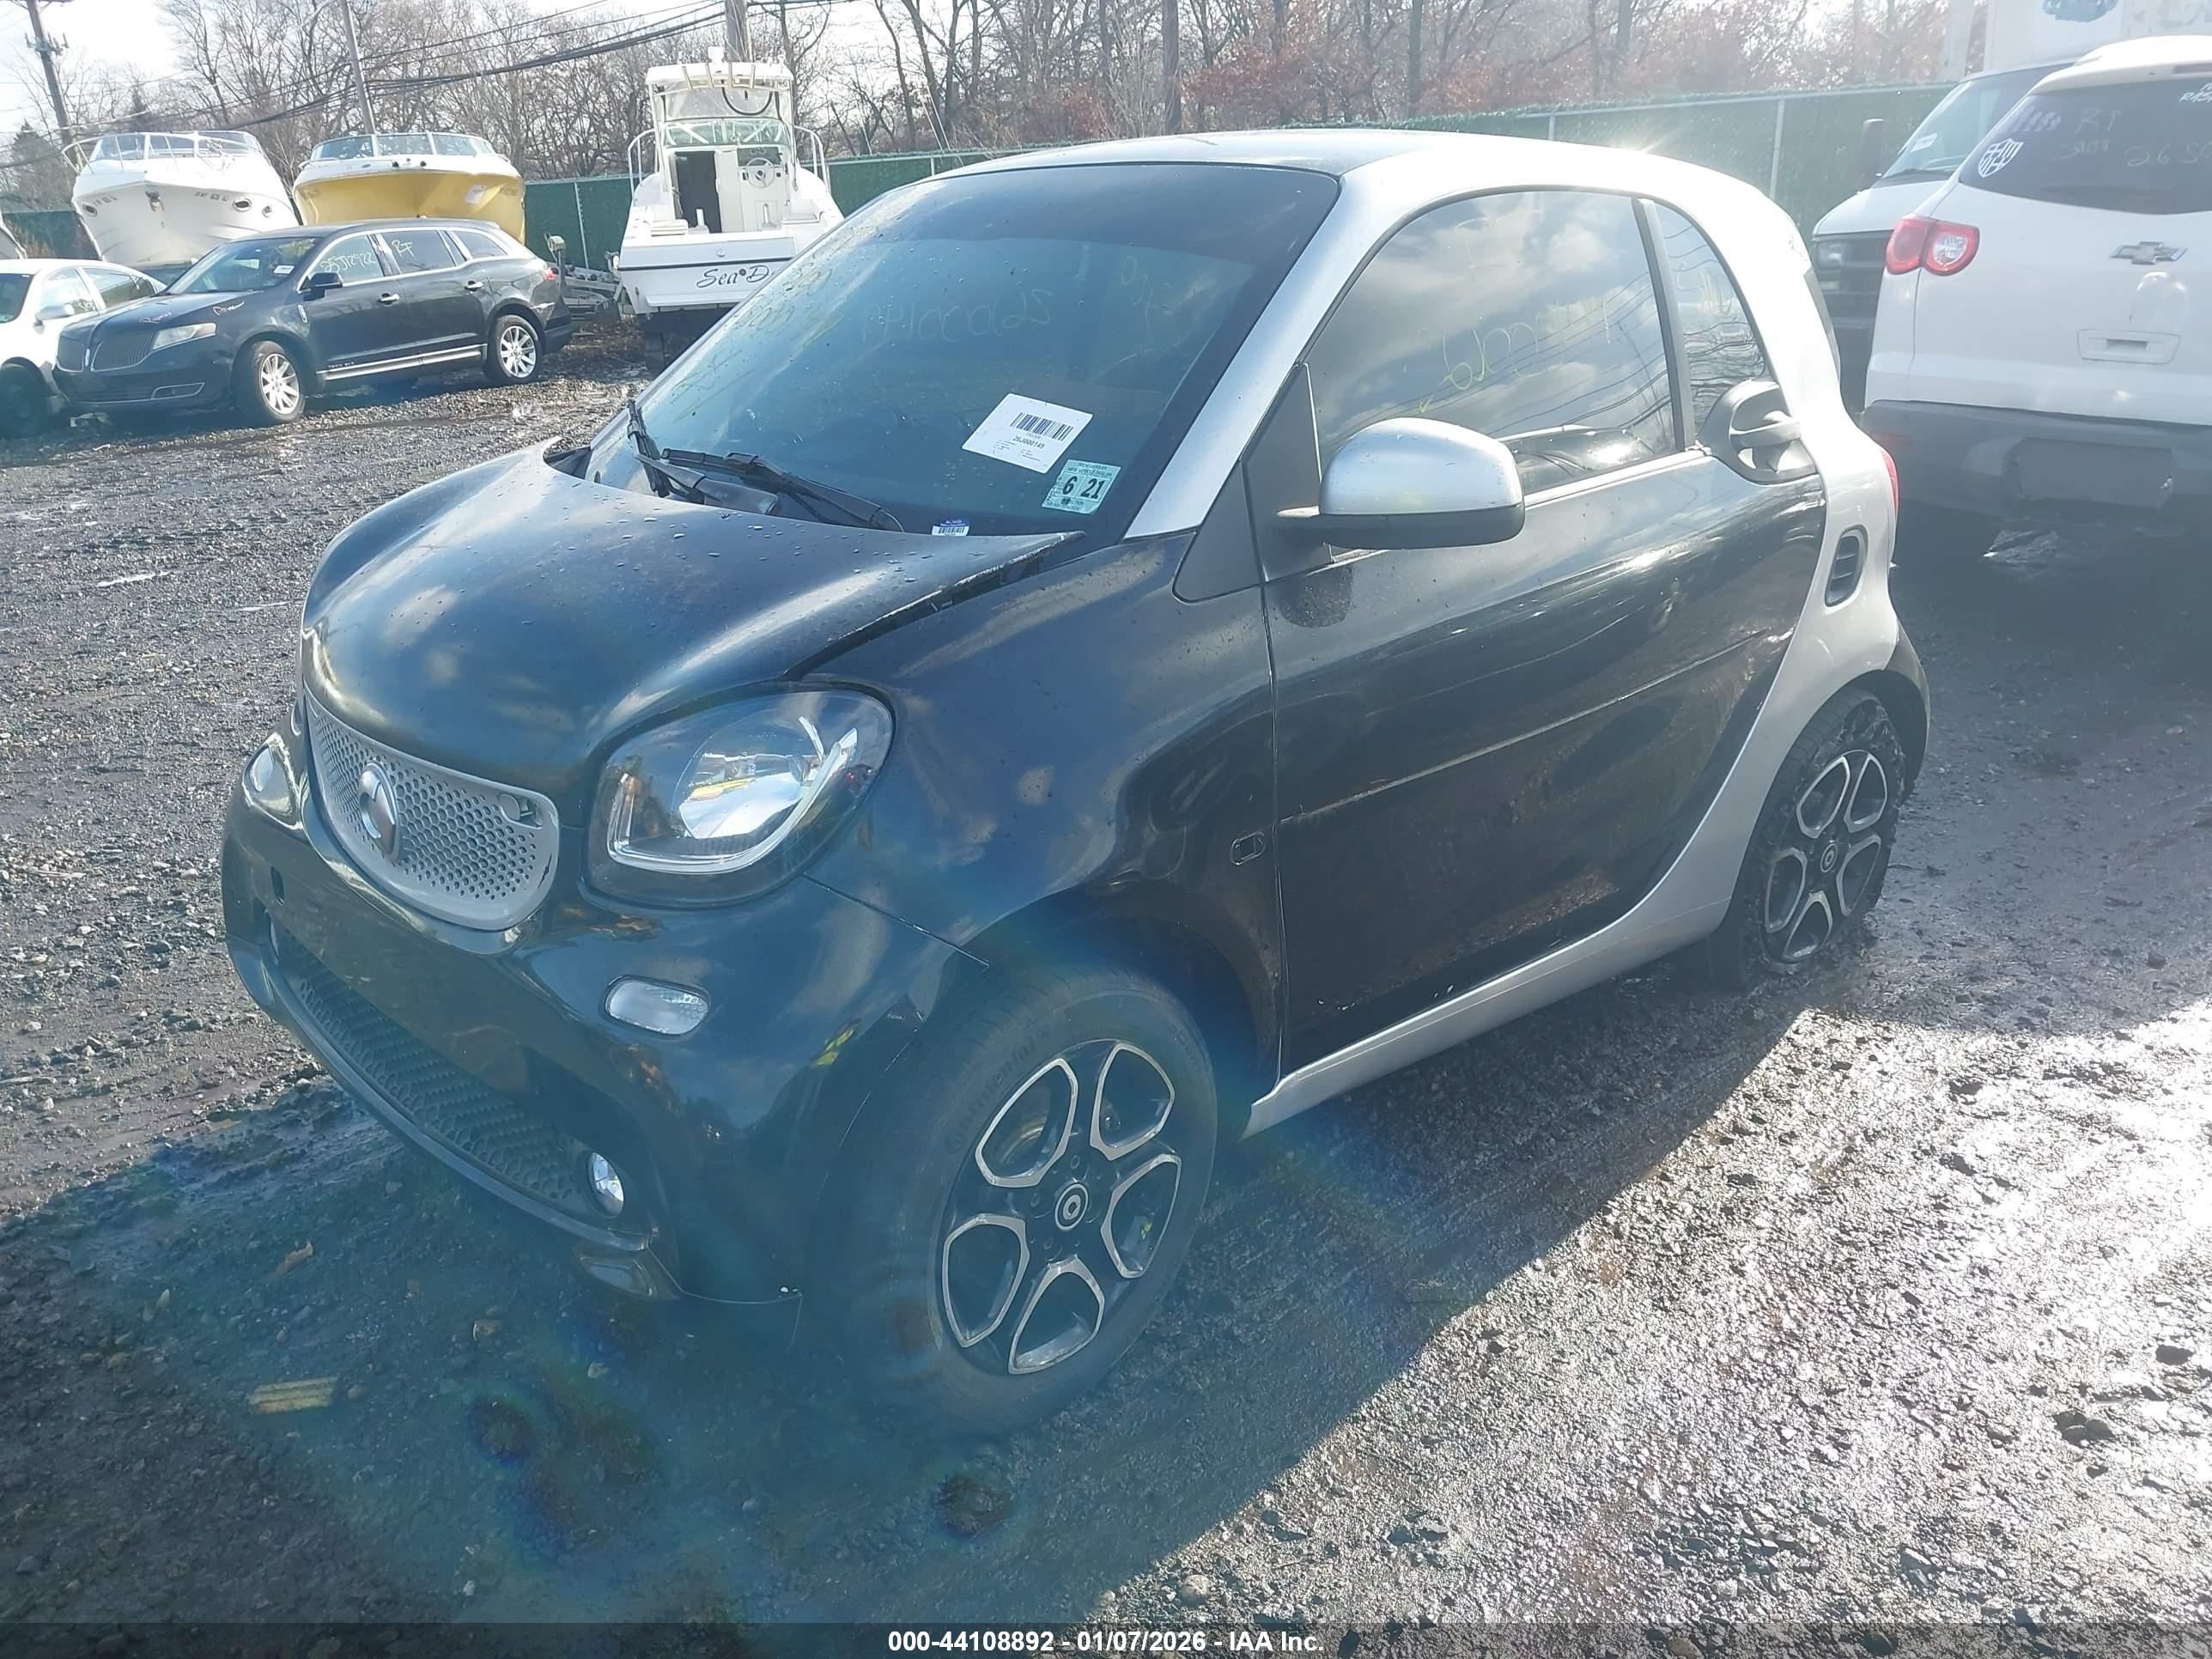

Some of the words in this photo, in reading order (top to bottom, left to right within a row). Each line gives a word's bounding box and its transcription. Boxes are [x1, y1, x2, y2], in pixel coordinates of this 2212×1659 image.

[2179, 90, 2212, 103] RAS
[696, 268, 738, 289] Sea
[1062, 476, 1079, 495] 6
[1080, 477, 1105, 499] 21
